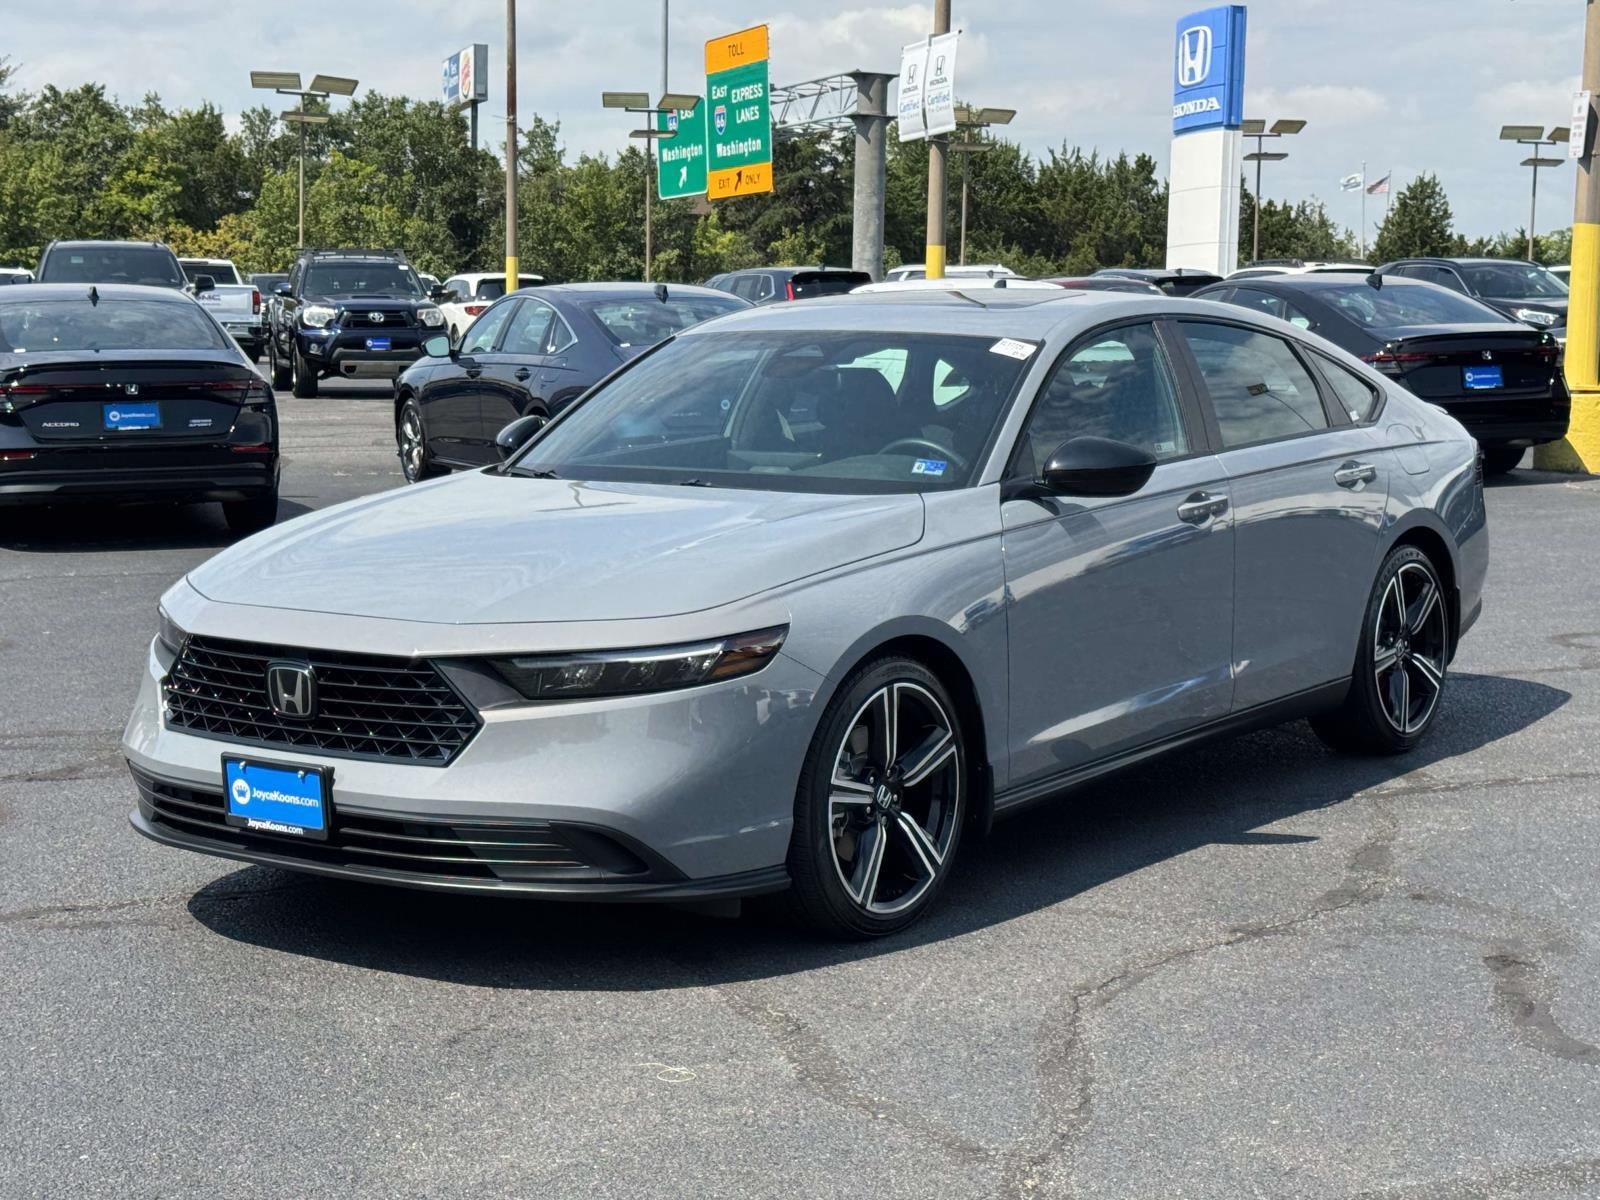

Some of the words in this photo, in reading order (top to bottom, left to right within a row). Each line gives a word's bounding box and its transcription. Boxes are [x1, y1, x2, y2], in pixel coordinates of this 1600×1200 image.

[728, 43, 745, 58] TOLL
[712, 85, 728, 100] EAST
[731, 83, 763, 103] EXPRESS
[716, 115, 725, 128] 66
[736, 106, 760, 124] LANES
[1173, 96, 1221, 118] HONDA
[662, 144, 703, 162] Washington
[716, 138, 762, 158] Washington
[718, 178, 731, 189] EXIT
[745, 173, 761, 185] ONLY
[252, 787, 319, 808] JoyceKoons.com
[247, 818, 304, 835] JoyceKoons.com
